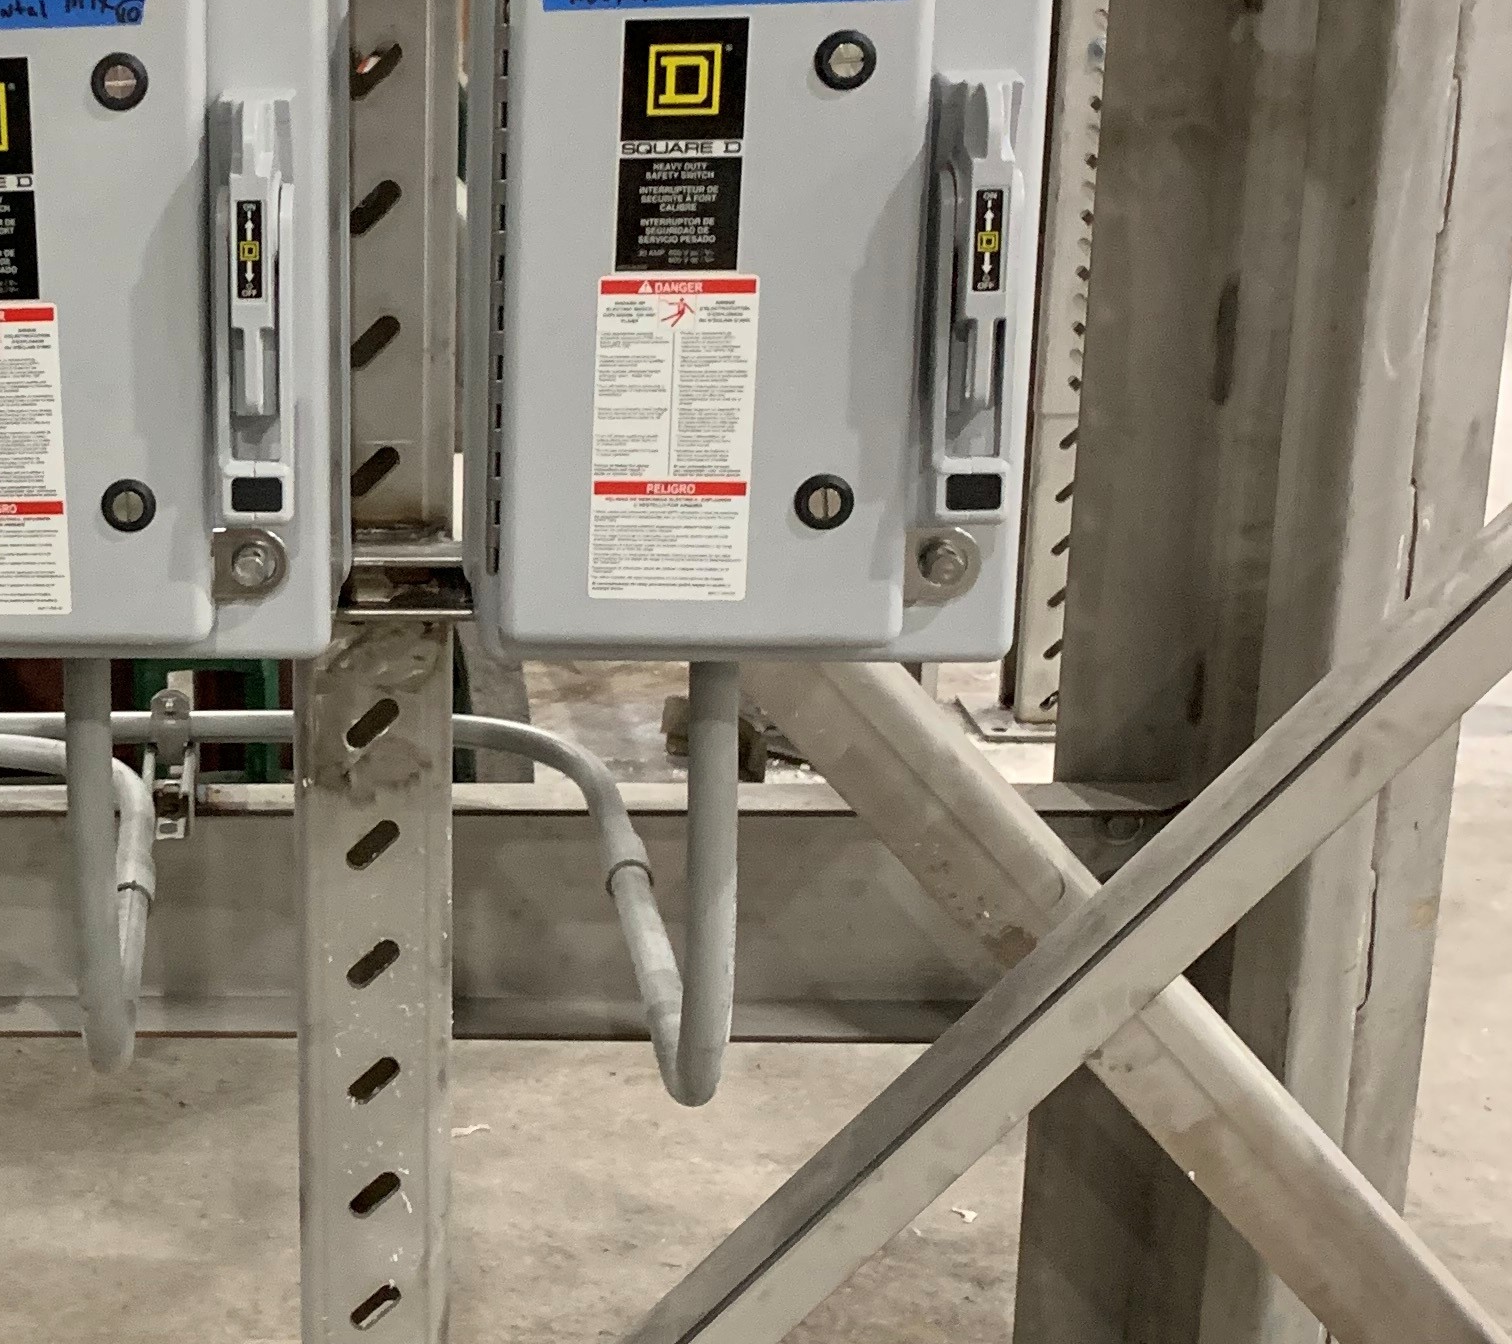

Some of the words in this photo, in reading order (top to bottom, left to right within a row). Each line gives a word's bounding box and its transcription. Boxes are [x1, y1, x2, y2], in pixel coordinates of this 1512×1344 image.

[621, 141, 713, 155] SQUARE
[723, 141, 742, 154] D
[16, 176, 33, 188] D
[655, 282, 704, 293] DANGER
[646, 483, 696, 494] PELIGRO
